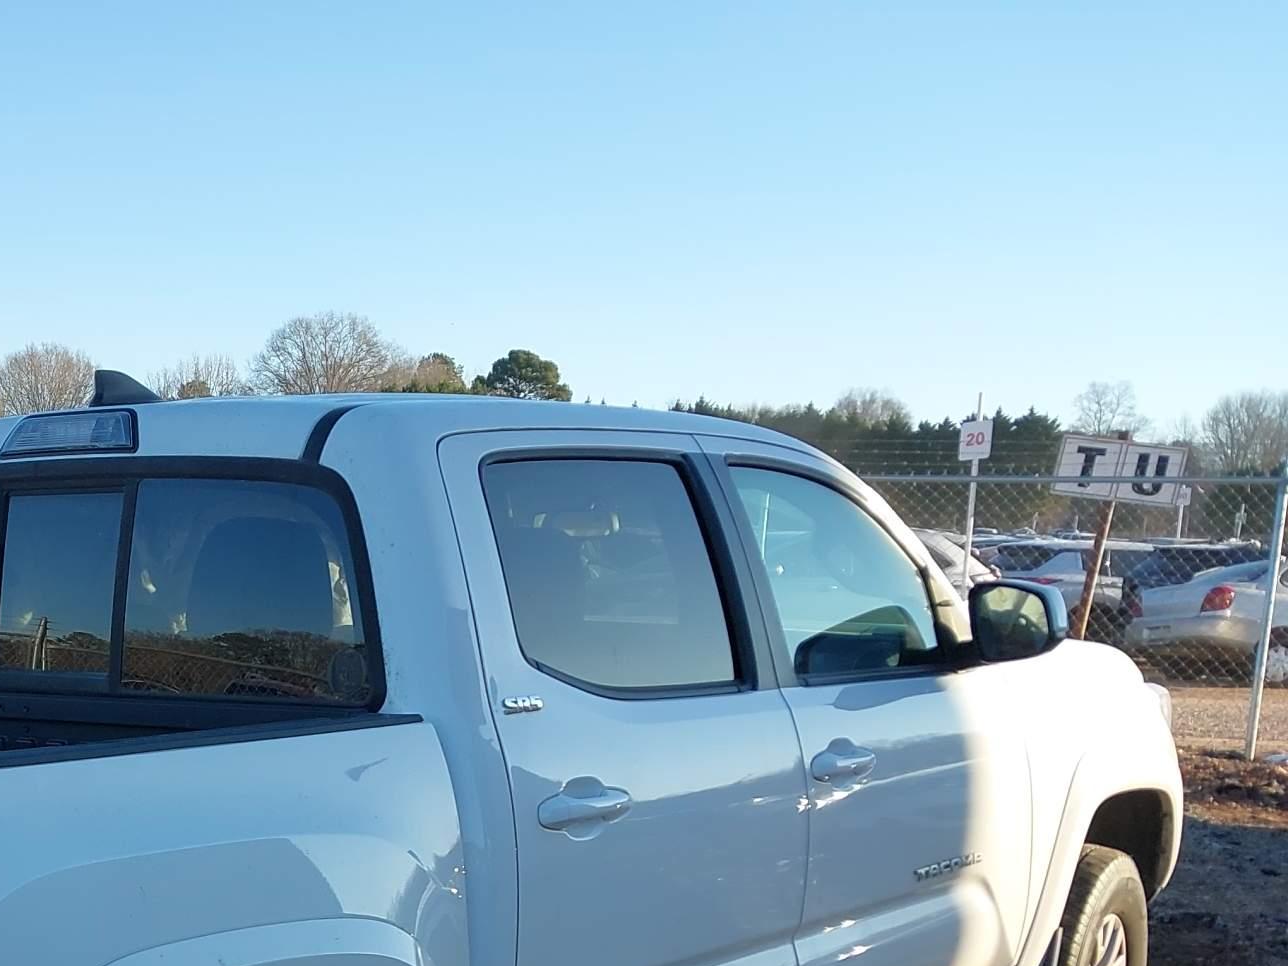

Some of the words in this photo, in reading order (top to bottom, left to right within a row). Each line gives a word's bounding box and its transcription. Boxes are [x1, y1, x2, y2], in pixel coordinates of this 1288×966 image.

[966, 431, 985, 446] 20
[1077, 445, 1107, 489] T
[1132, 453, 1169, 496] U
